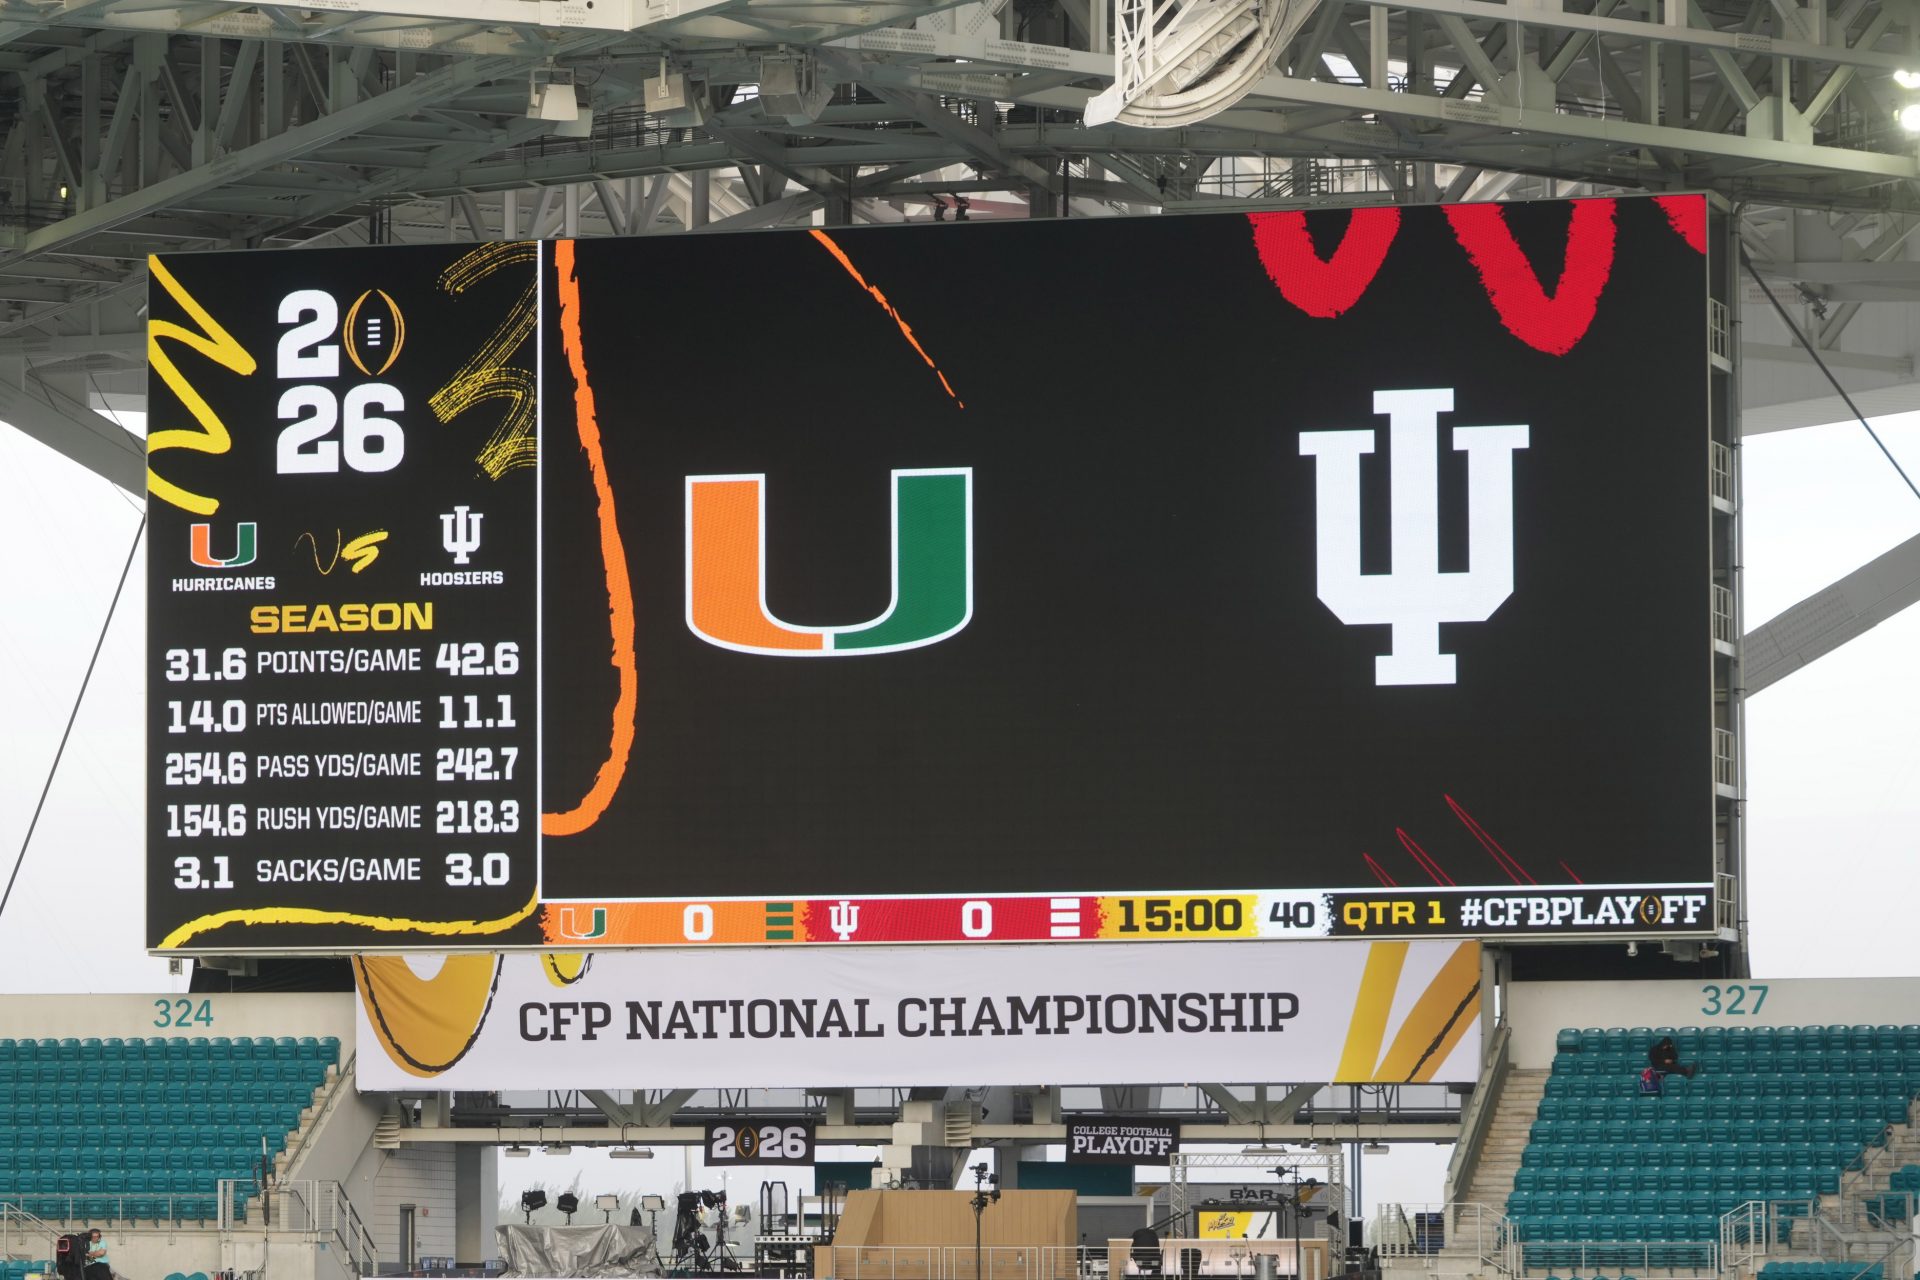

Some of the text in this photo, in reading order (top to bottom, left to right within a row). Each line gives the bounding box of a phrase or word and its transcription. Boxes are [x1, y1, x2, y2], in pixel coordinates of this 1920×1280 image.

[277, 383, 404, 474] 26
[173, 577, 275, 591] HURRICANES
[421, 571, 503, 586] HOOSIERS
[251, 602, 432, 633] SEASON
[166, 642, 519, 681] 31.6 POINTS/GAME 42.6
[169, 695, 516, 733] 14.0 PTS ALLOWED/GAME 11.1
[166, 747, 518, 785] 254.6 PASS YDS/GAME 242.7
[167, 800, 519, 837] 154.6 RUSH YDS/GAME 218.3
[175, 853, 509, 889] 3.1 SACKS/GAME 3.0
[683, 904, 713, 941] 0
[962, 901, 993, 938] 0
[1119, 898, 1242, 934] 15:00
[1270, 902, 1315, 928] 40
[1344, 901, 1445, 931] QTR 1
[153, 999, 214, 1028] 324
[1702, 985, 1768, 1015] 327
[520, 993, 1299, 1041] CFP NATIONAL CHAMPIONSHIP
[1073, 1126, 1172, 1137] COLLEGE FOOTBALL
[1073, 1135, 1171, 1156] PLAYOFF
[1231, 1189, 1274, 1199] BAR
